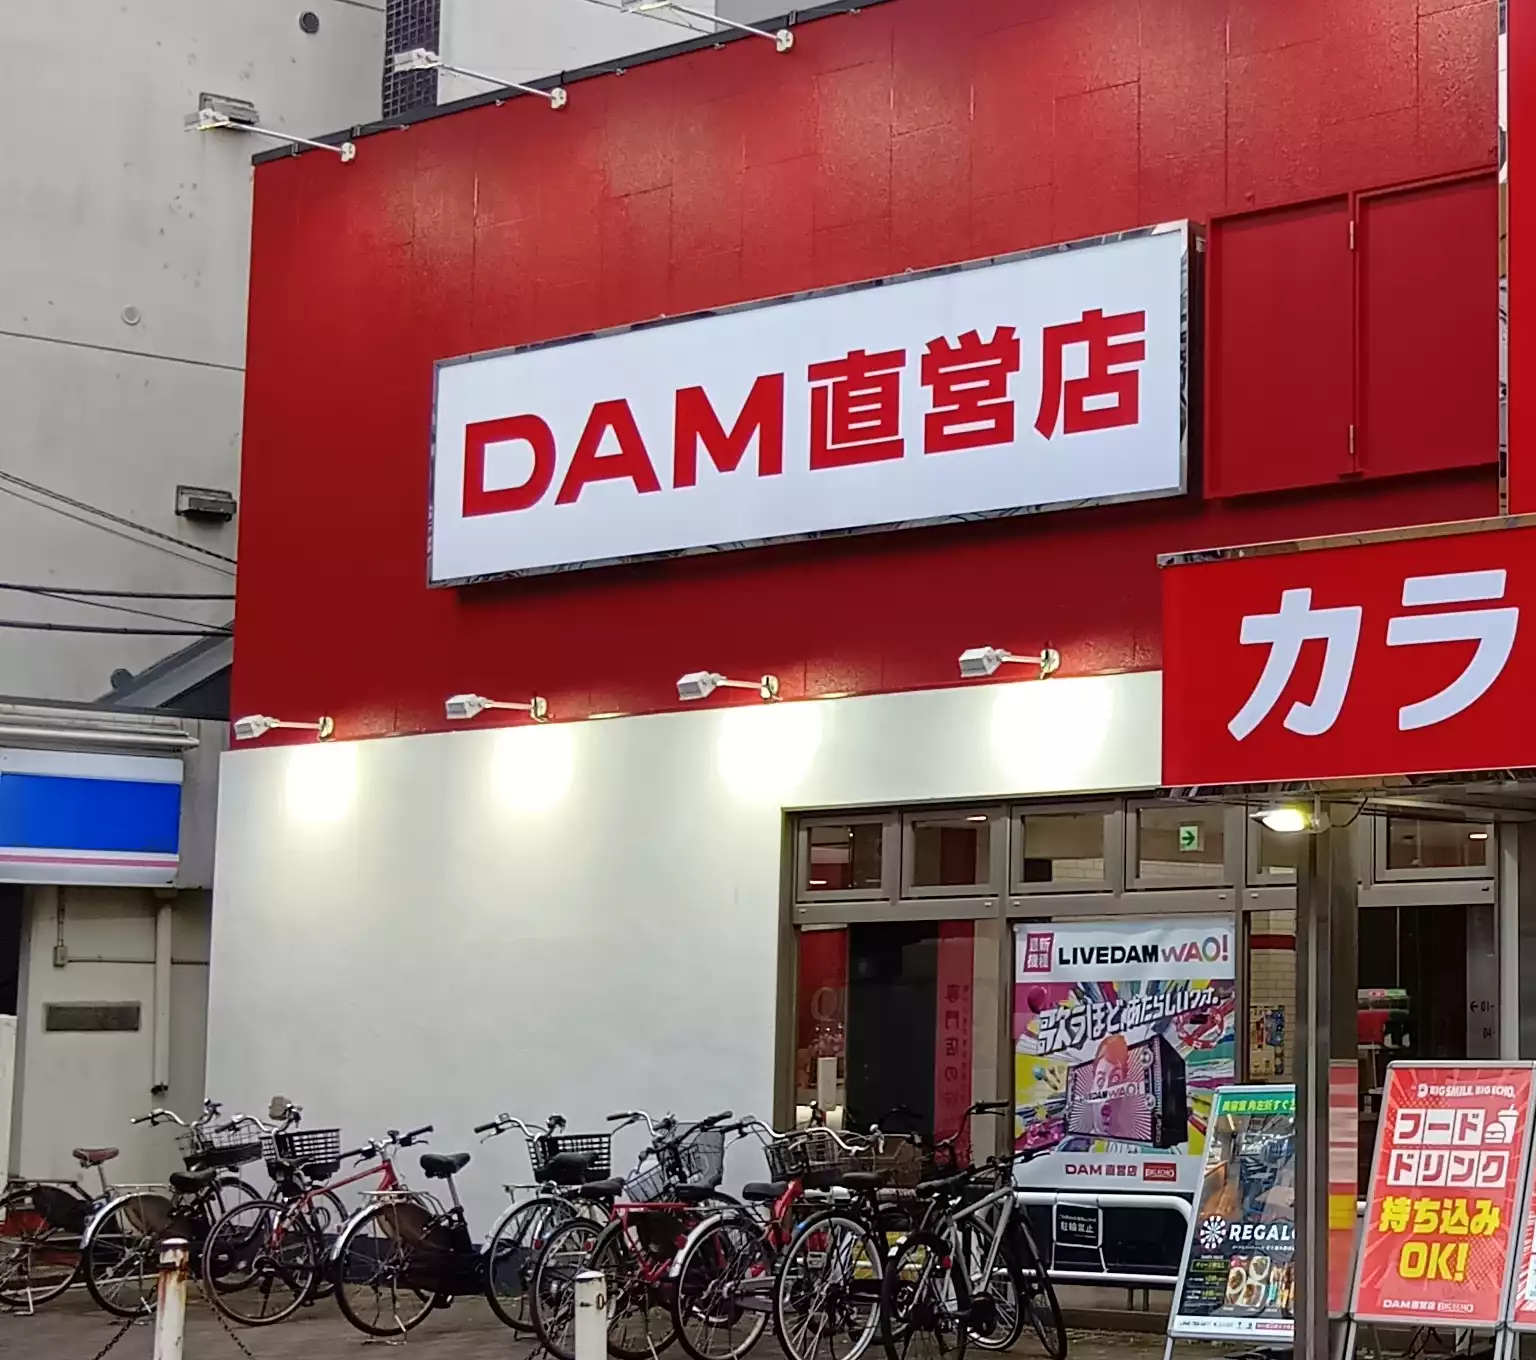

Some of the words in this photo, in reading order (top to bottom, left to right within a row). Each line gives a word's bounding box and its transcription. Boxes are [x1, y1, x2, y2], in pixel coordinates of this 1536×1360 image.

[461, 308, 1147, 518] DAM直営店
[1058, 944, 1159, 965] LIVEDAM
[1161, 934, 1228, 965] WAO!
[1398, 1112, 1480, 1142] フード
[1393, 1153, 1505, 1183] ドリンク
[1378, 1195, 1500, 1236] 持ち込み
[1229, 1224, 1295, 1242] REGAL
[1399, 1241, 1469, 1282] OK!
